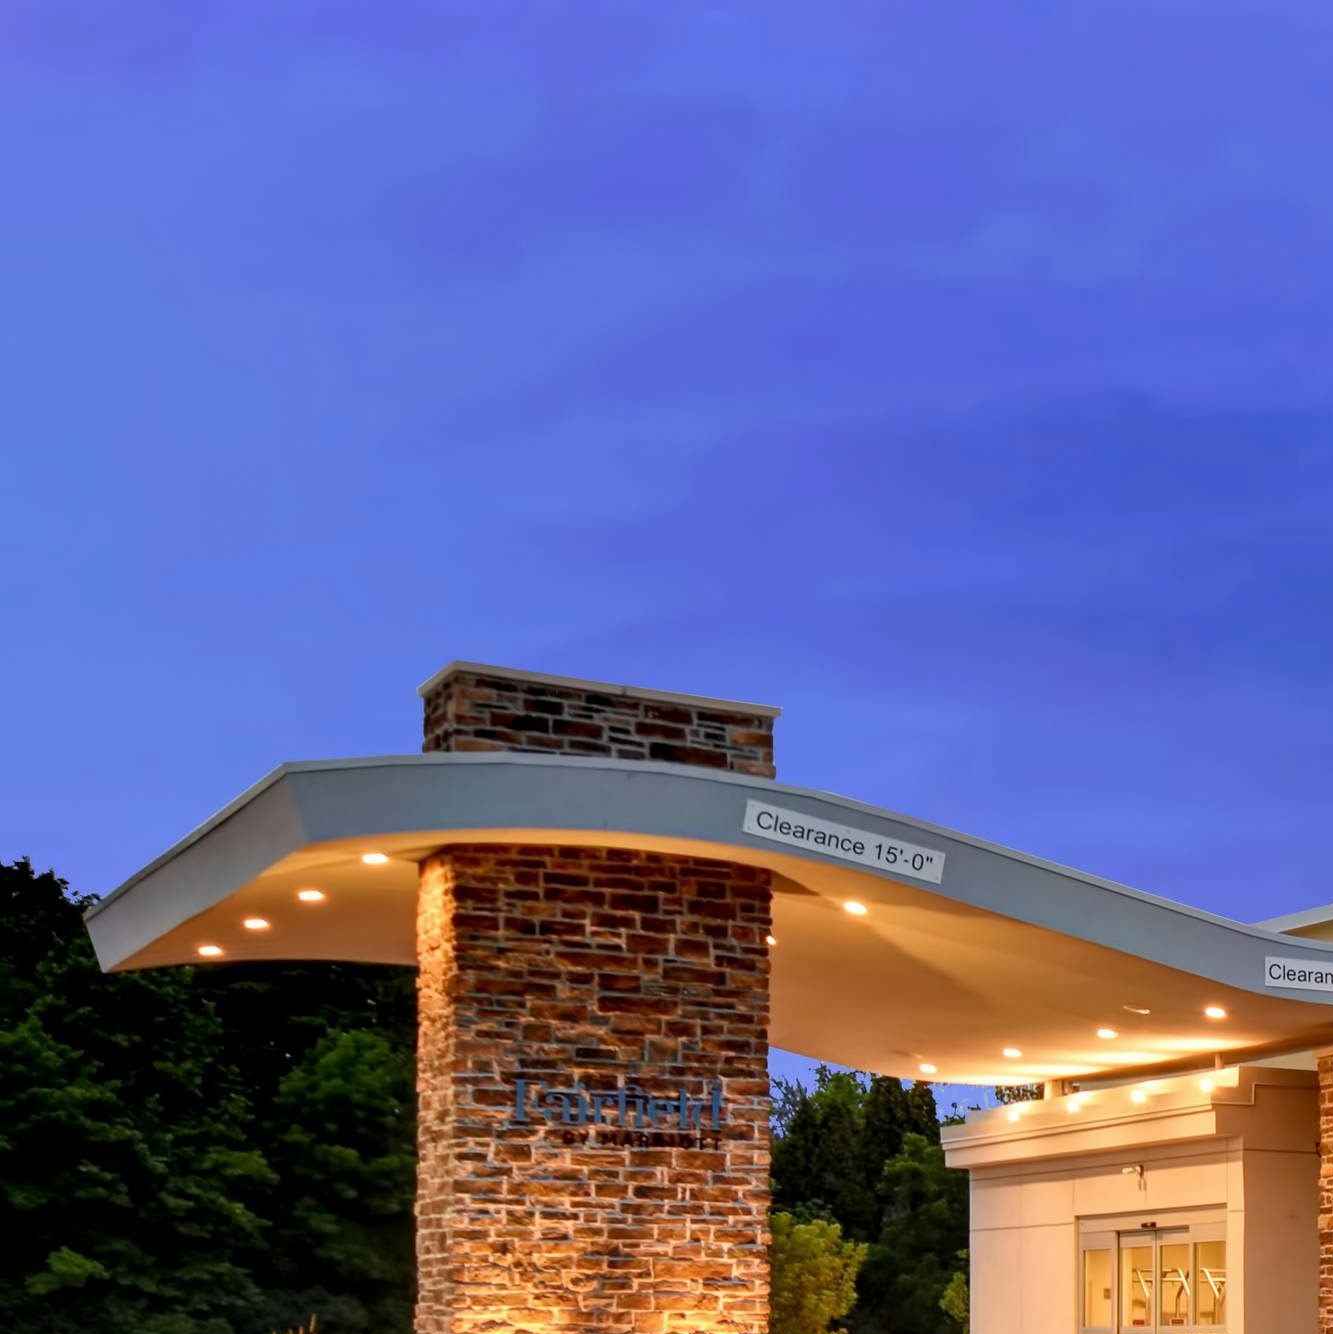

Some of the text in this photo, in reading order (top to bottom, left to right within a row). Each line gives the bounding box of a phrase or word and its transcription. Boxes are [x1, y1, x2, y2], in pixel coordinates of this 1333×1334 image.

[756, 811, 934, 872] Clearance 15'-0"
[514, 1078, 723, 1131] Fairfield
